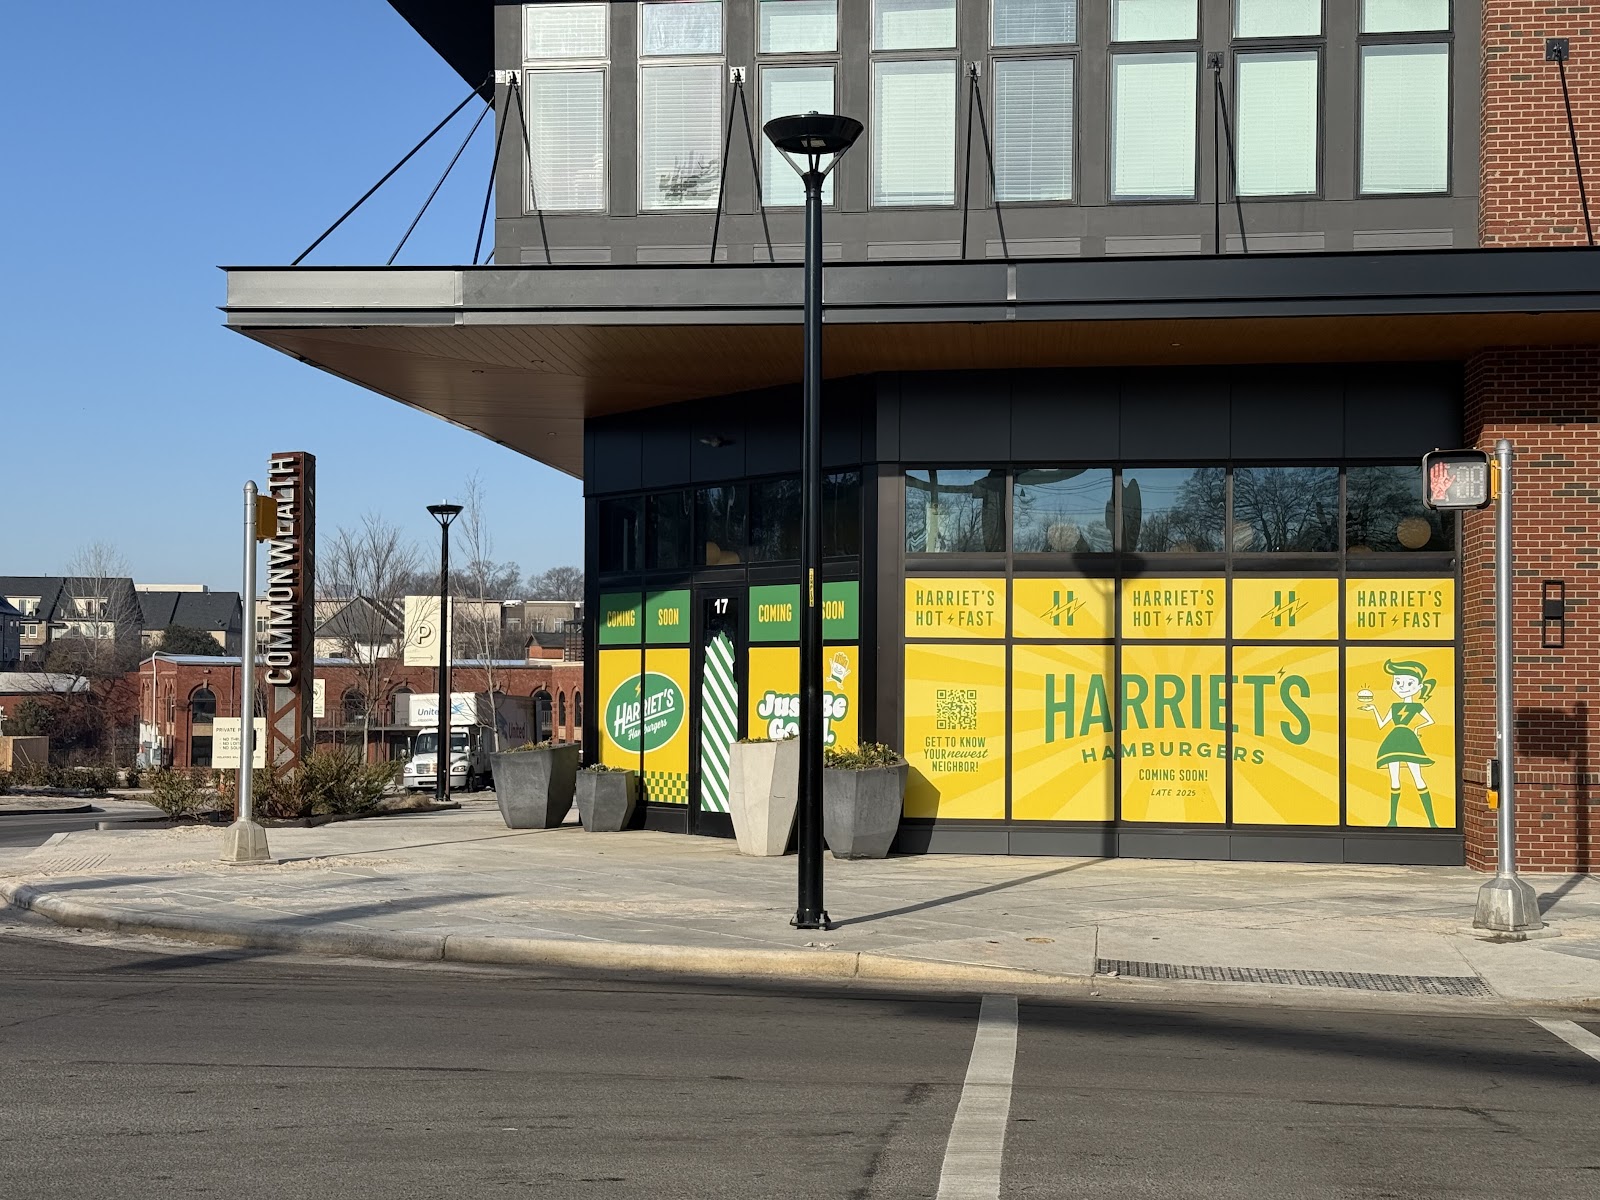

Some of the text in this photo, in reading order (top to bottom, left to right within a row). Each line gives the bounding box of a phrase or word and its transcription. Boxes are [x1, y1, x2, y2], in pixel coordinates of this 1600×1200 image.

[265, 457, 294, 685] COMMONWEALTH
[714, 598, 729, 614] 17
[916, 590, 995, 606] HARRIET'S
[1133, 590, 1214, 606] HARRIET'S
[1357, 590, 1442, 607] HARRIET'S
[607, 608, 679, 628] COMING SOON
[758, 603, 792, 622] COMING
[916, 610, 994, 627] HOT FAST
[1133, 610, 1214, 627] HOT FAST
[1357, 611, 1442, 628] HOT FAST
[416, 624, 432, 645] P
[418, 707, 439, 716] Unite
[758, 694, 800, 717] Jus
[925, 736, 986, 748] GET TO KNOW
[923, 748, 989, 760] YOUR newest
[1082, 742, 1265, 764] HAMBURGERS
[932, 760, 979, 772] NEIGHBOR!
[1139, 769, 1208, 782] COMING SOON!
[1176, 789, 1197, 797] 2025
